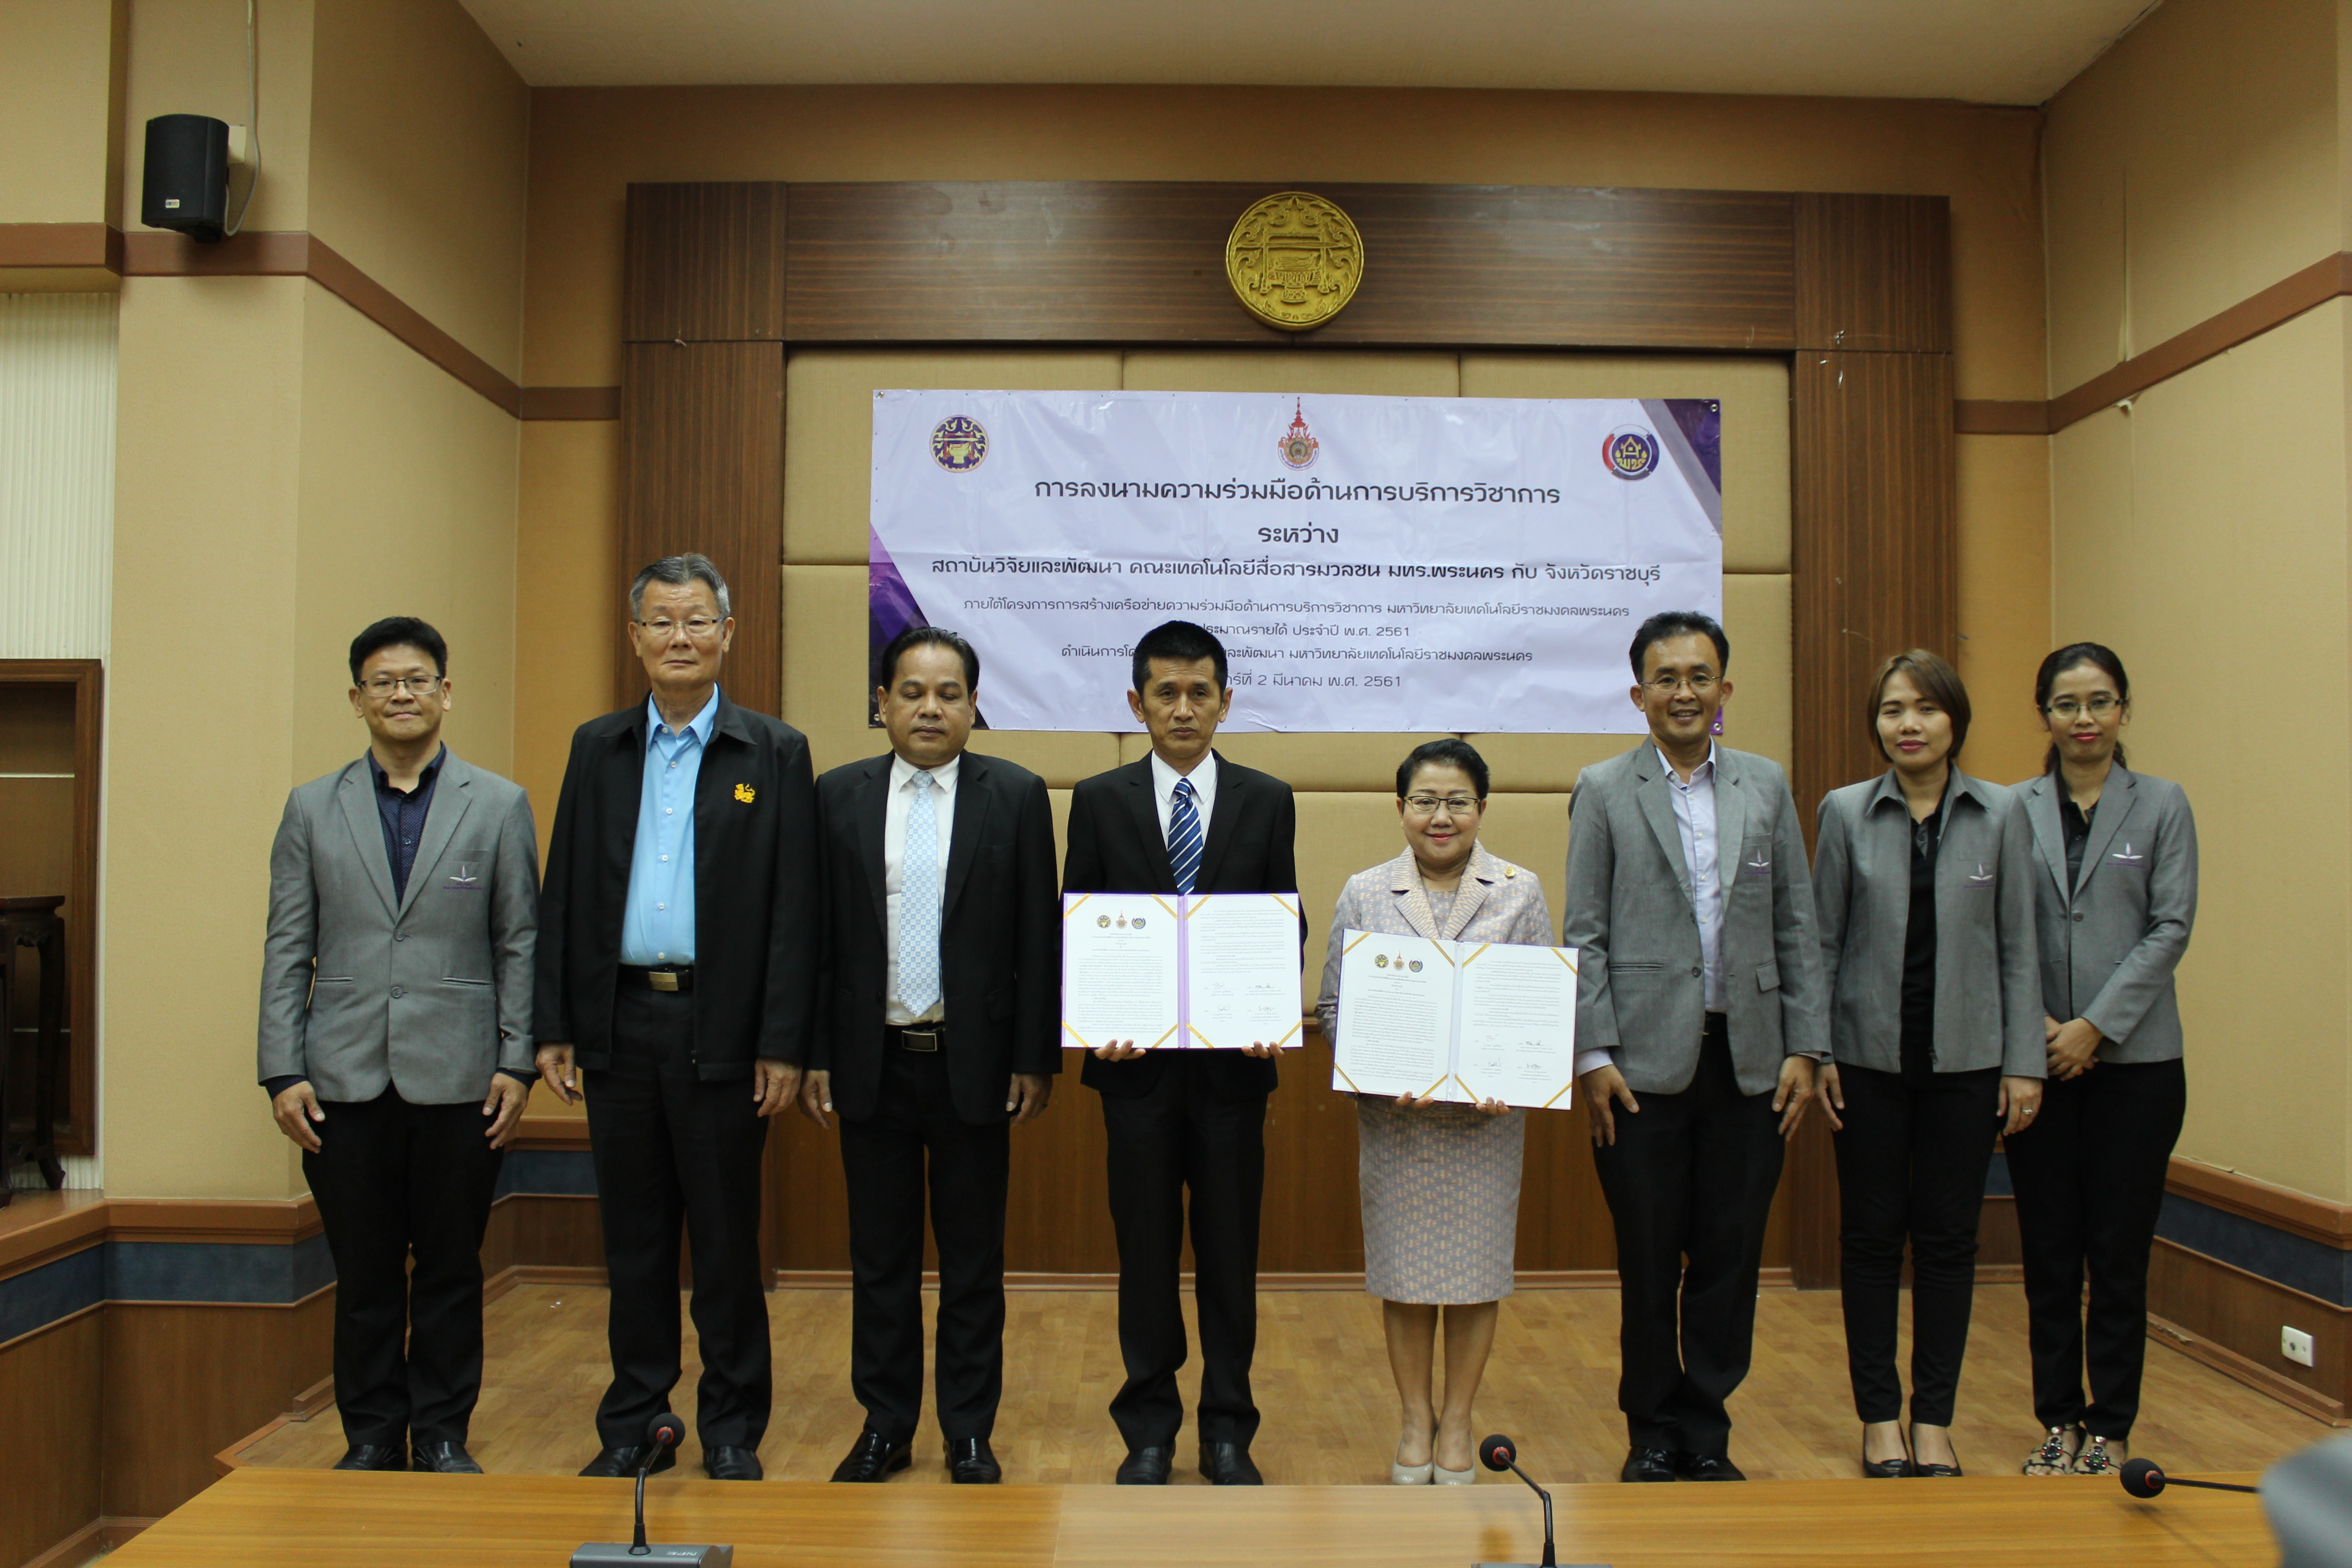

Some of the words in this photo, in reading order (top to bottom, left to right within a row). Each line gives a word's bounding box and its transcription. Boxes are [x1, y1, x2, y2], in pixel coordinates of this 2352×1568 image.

[1035, 477, 1560, 503] การลงนามความร่วมมือด้านการบริการวิชาการ
[1258, 522, 1338, 543] ระหว่าง
[932, 556, 1121, 574] สถาบันวิจัยและพัฒนา
[1130, 555, 1381, 577] คณะเทคโนโลยีสื่อสารมวลชน
[1388, 564, 1504, 578] มทร.พระนคร
[1511, 563, 1537, 579] กับ
[1545, 563, 1660, 586] จังหวัดราชบุรี
[965, 597, 1382, 613] ภายใต้โครงการการสร้างเครือข่ายความร่วมมือด้านการบริการวิชาการ
[1387, 603, 1629, 617] มหาวิทยาลัยเทคโนโลยีราชมงคลพระนคร
[1293, 624, 1338, 636] ประจำปี
[1345, 627, 1370, 636] พ.ศ.
[1377, 627, 1408, 636] 2561
[1289, 647, 1532, 661] มหาวิทยาลัยเทคโนโลยีราชมงคลพระนคร
[1258, 675, 1266, 685] 2
[1273, 673, 1322, 686] มีนาคม
[1329, 676, 1357, 686] พ.ศ.
[1364, 676, 1400, 686] 2561
